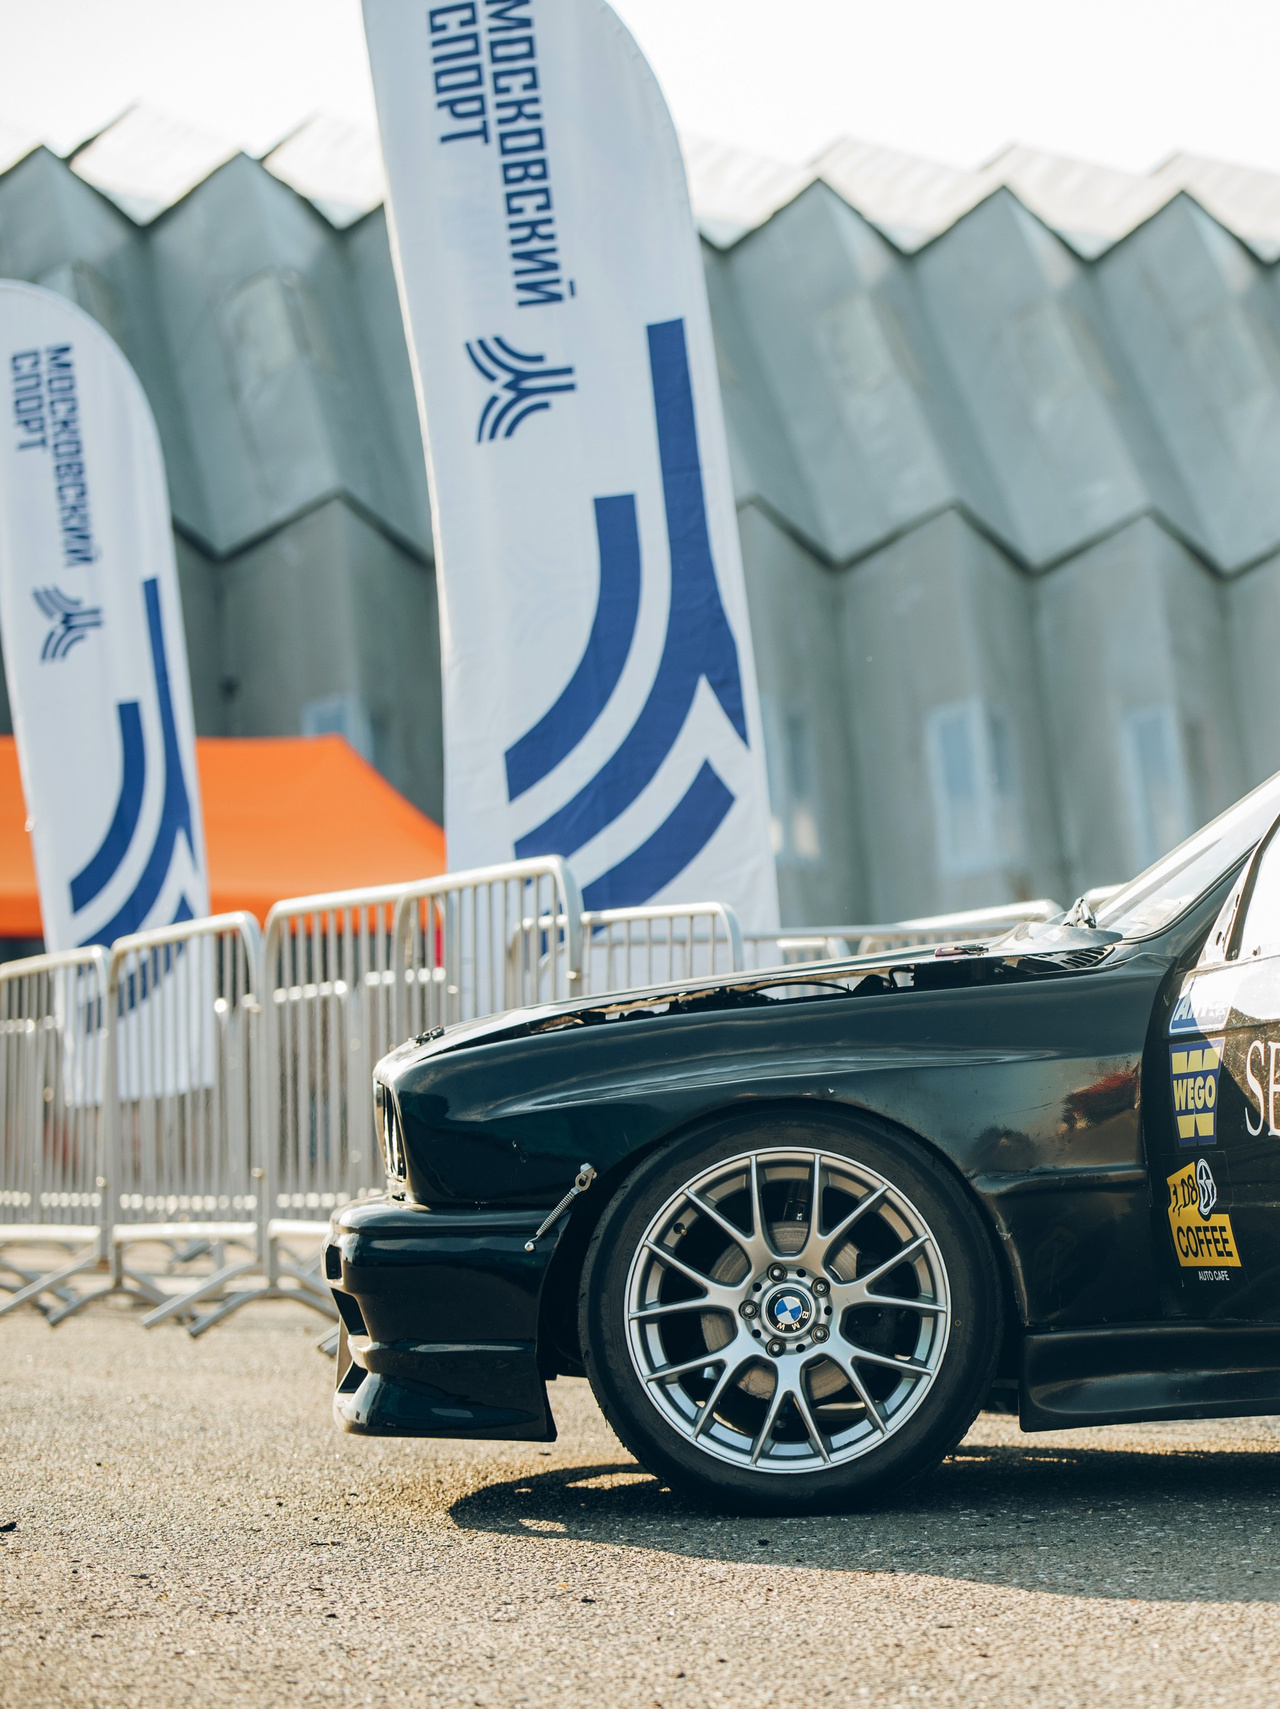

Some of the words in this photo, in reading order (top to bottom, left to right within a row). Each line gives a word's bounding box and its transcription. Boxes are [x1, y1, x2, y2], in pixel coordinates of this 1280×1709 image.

[428, 1, 490, 145] СПОРТ
[484, 0, 577, 308] МОСКОВСКИЙ
[11, 347, 48, 453] СПОРТ
[46, 342, 102, 567] МОСКОВСКИЙ
[1173, 1075, 1216, 1111] WEGO
[1177, 1225, 1233, 1258] COFFEE
[1198, 1270, 1213, 1281] AUTO
[1213, 1270, 1230, 1281] CAFE
